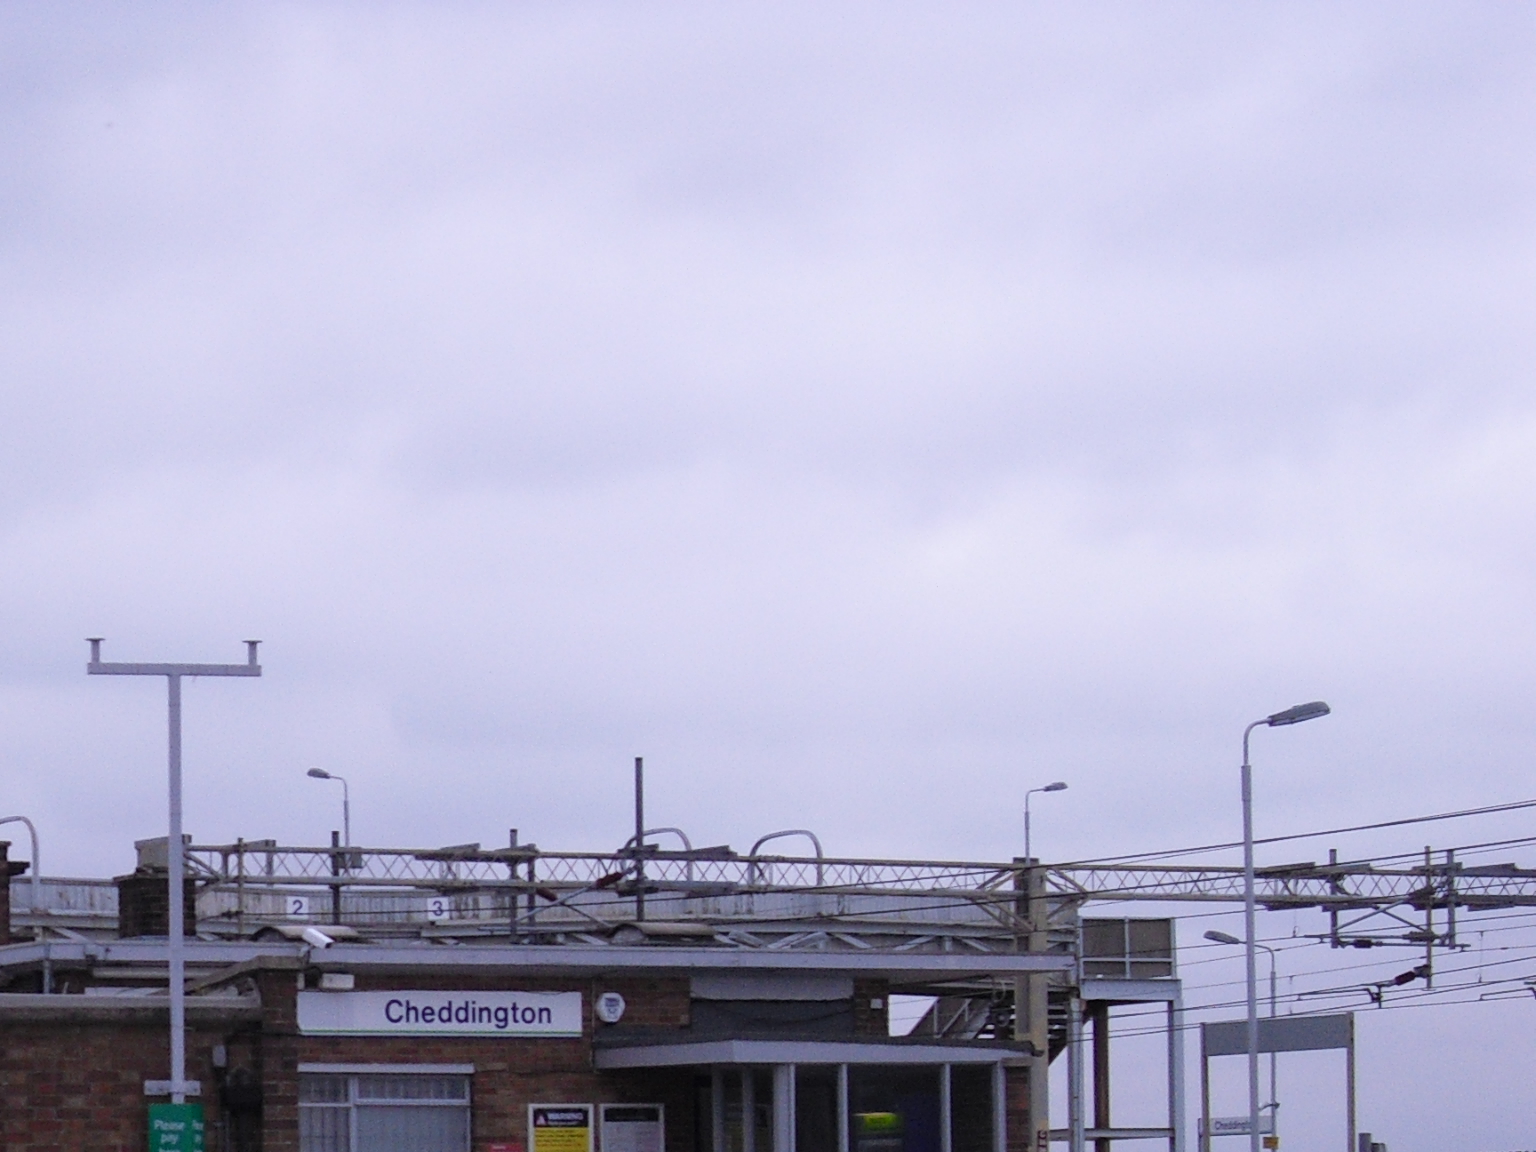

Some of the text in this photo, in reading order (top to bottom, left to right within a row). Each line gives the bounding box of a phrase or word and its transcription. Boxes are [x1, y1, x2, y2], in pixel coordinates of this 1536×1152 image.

[292, 899, 304, 915] 2
[432, 900, 445, 916] 3
[384, 999, 552, 1029] Cheddington
